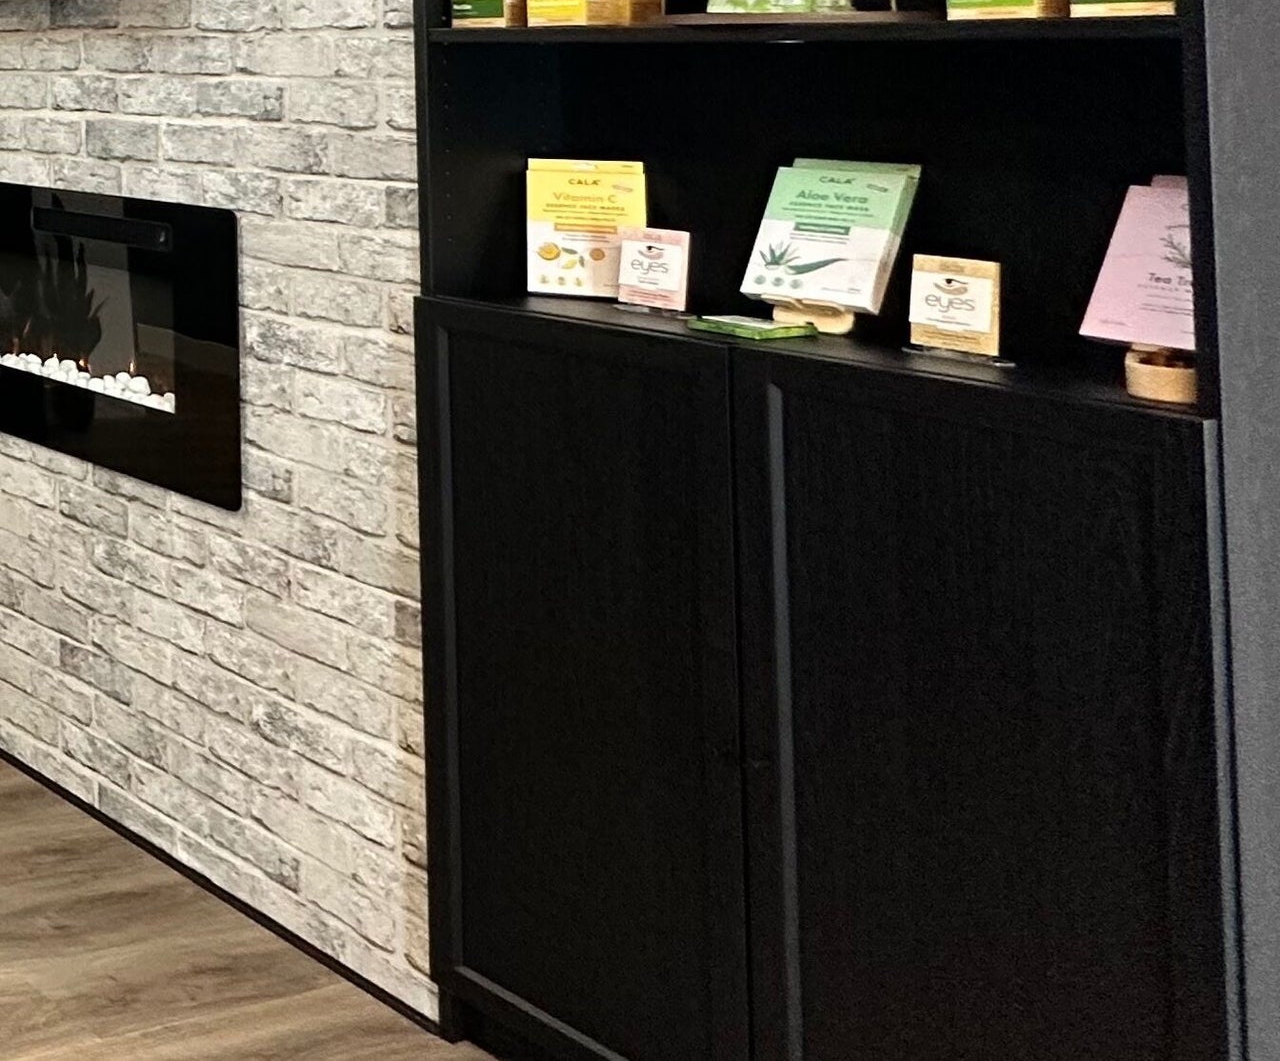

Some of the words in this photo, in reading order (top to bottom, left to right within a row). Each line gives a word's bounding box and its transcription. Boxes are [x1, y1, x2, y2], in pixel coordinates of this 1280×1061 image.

[568, 178, 600, 186] CALA
[553, 192, 604, 203] Vitamin
[607, 194, 617, 204] C
[796, 190, 829, 201] Aloe
[833, 192, 869, 204] Vera
[630, 259, 669, 276] eyes
[1148, 272, 1172, 285] Tea
[925, 293, 976, 313] eyes
